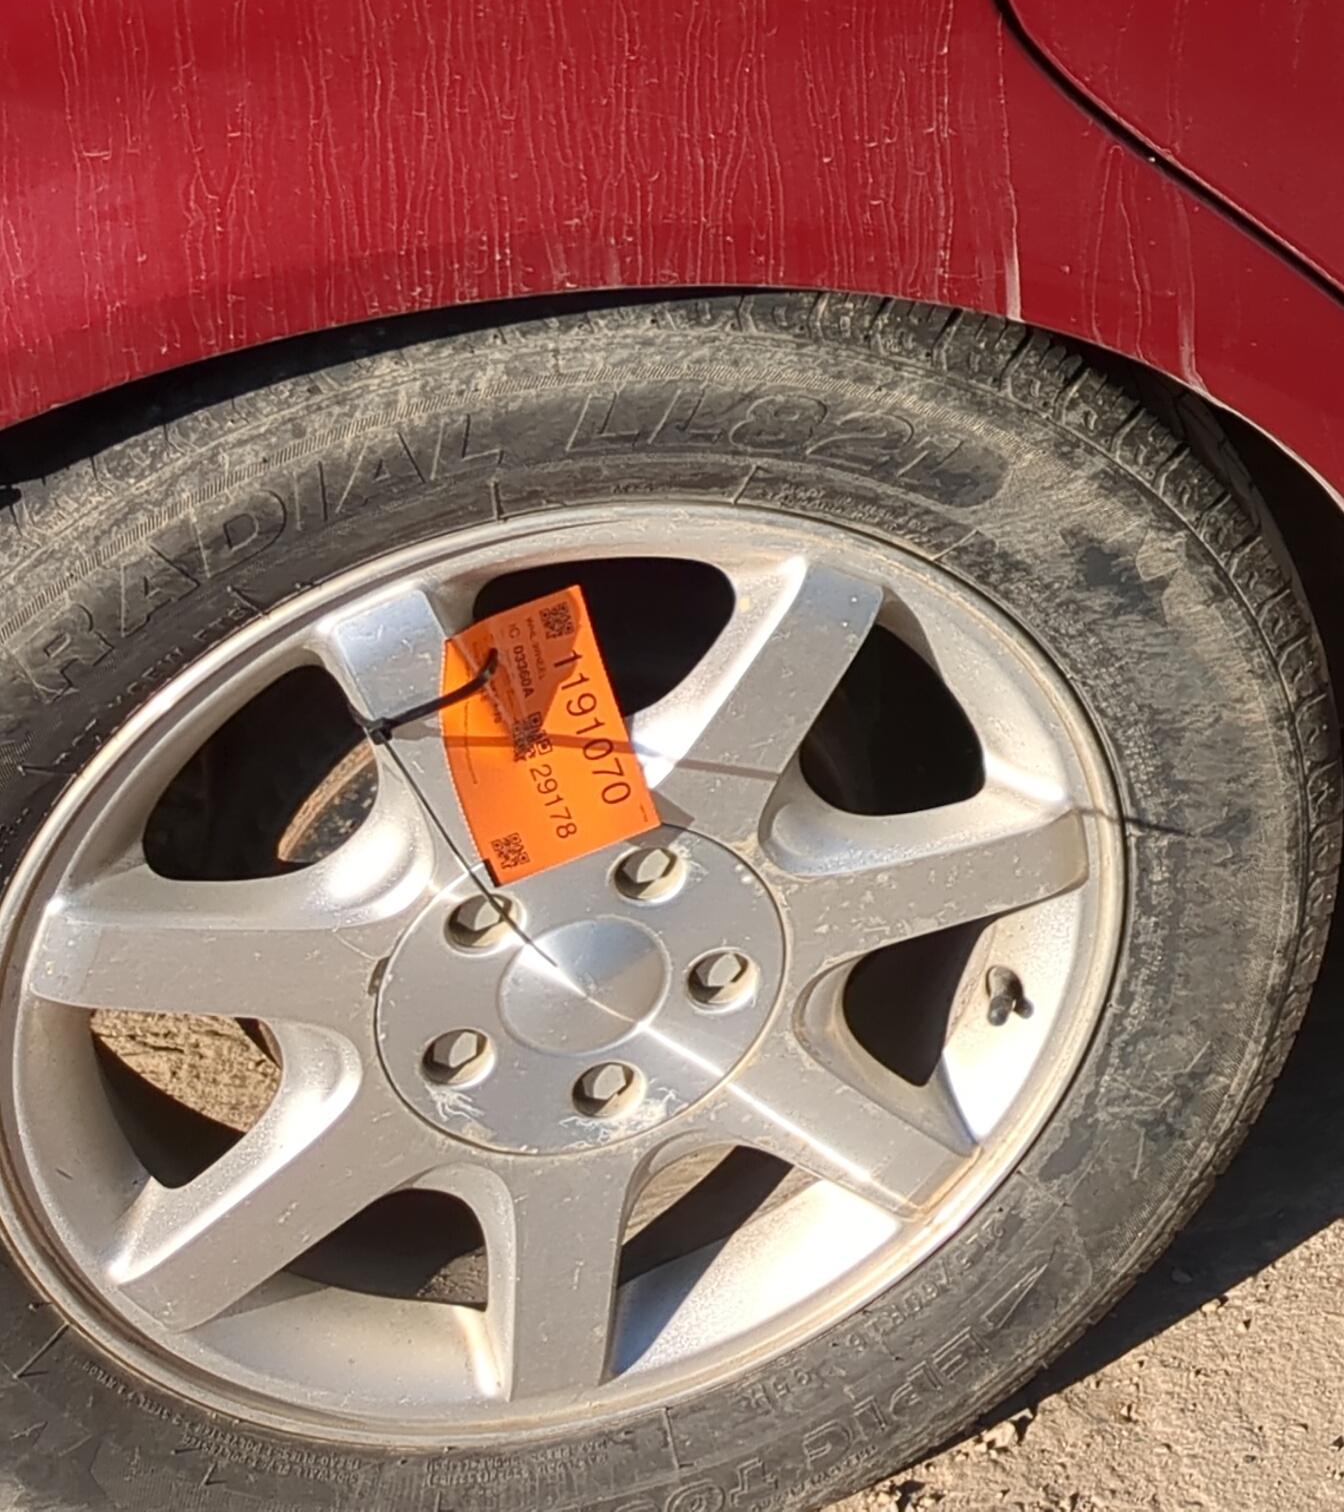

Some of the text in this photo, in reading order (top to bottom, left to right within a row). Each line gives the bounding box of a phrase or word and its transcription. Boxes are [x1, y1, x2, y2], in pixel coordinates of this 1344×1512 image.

[18, 411, 503, 703] RADIAL
[529, 763, 578, 839] 29178
[553, 649, 631, 805] 1191070
[801, 1324, 989, 1465] EPIC
